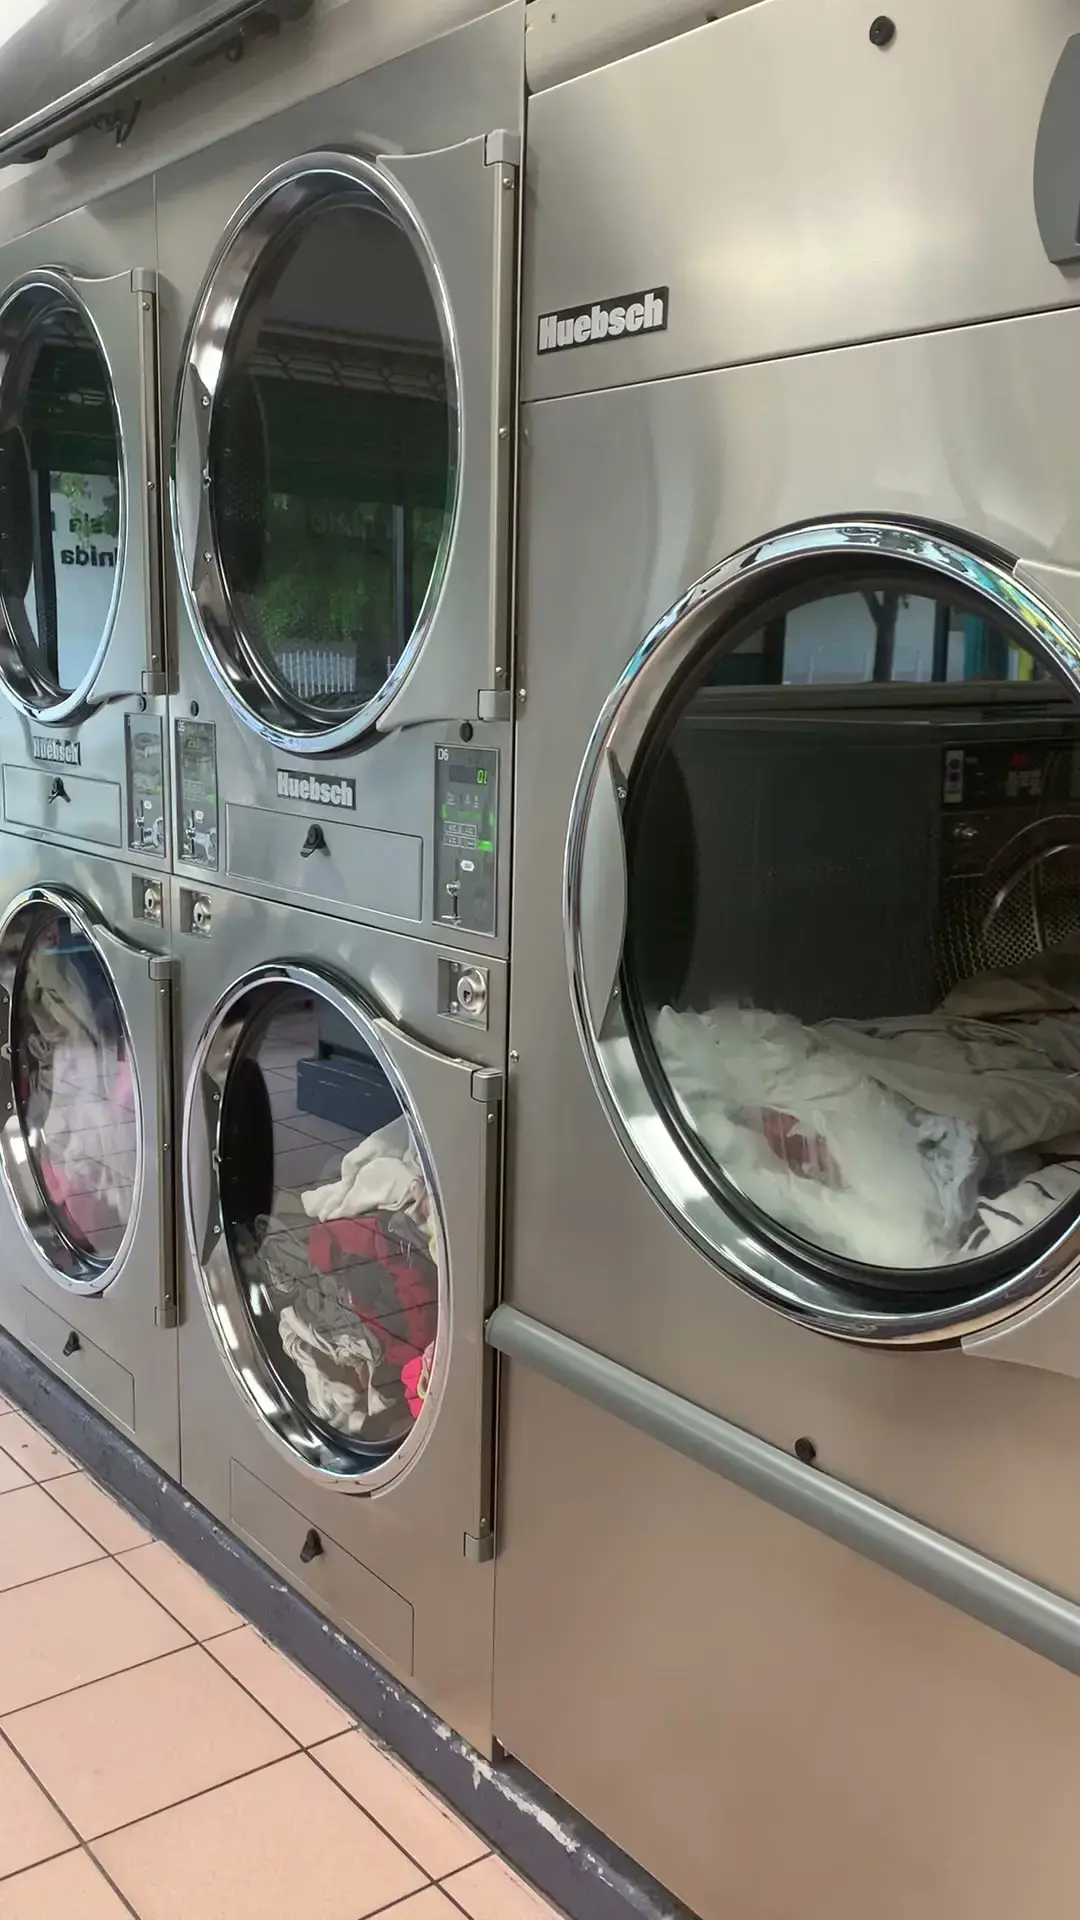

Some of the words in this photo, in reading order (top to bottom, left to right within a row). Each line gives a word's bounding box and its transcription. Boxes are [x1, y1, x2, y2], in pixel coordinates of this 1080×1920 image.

[539, 293, 663, 351] Huebsch
[438, 748, 449, 762] D6
[277, 771, 353, 806] Huebsch
